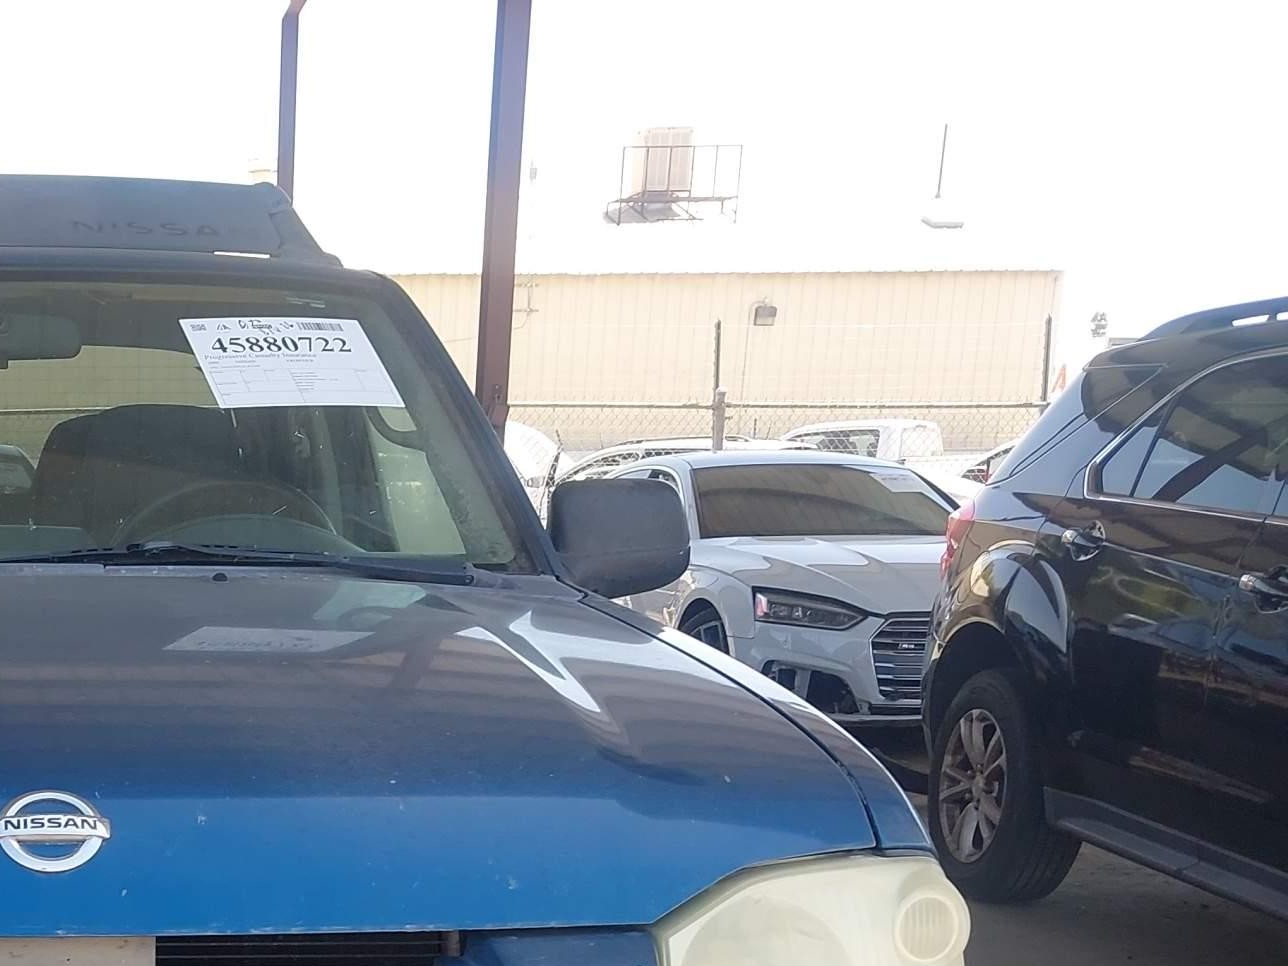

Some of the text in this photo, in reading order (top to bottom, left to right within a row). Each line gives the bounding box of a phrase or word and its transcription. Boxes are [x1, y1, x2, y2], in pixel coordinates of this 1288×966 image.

[70, 220, 258, 237] NISSA
[211, 336, 352, 354] 45880722
[3, 817, 98, 831] NISSAN
